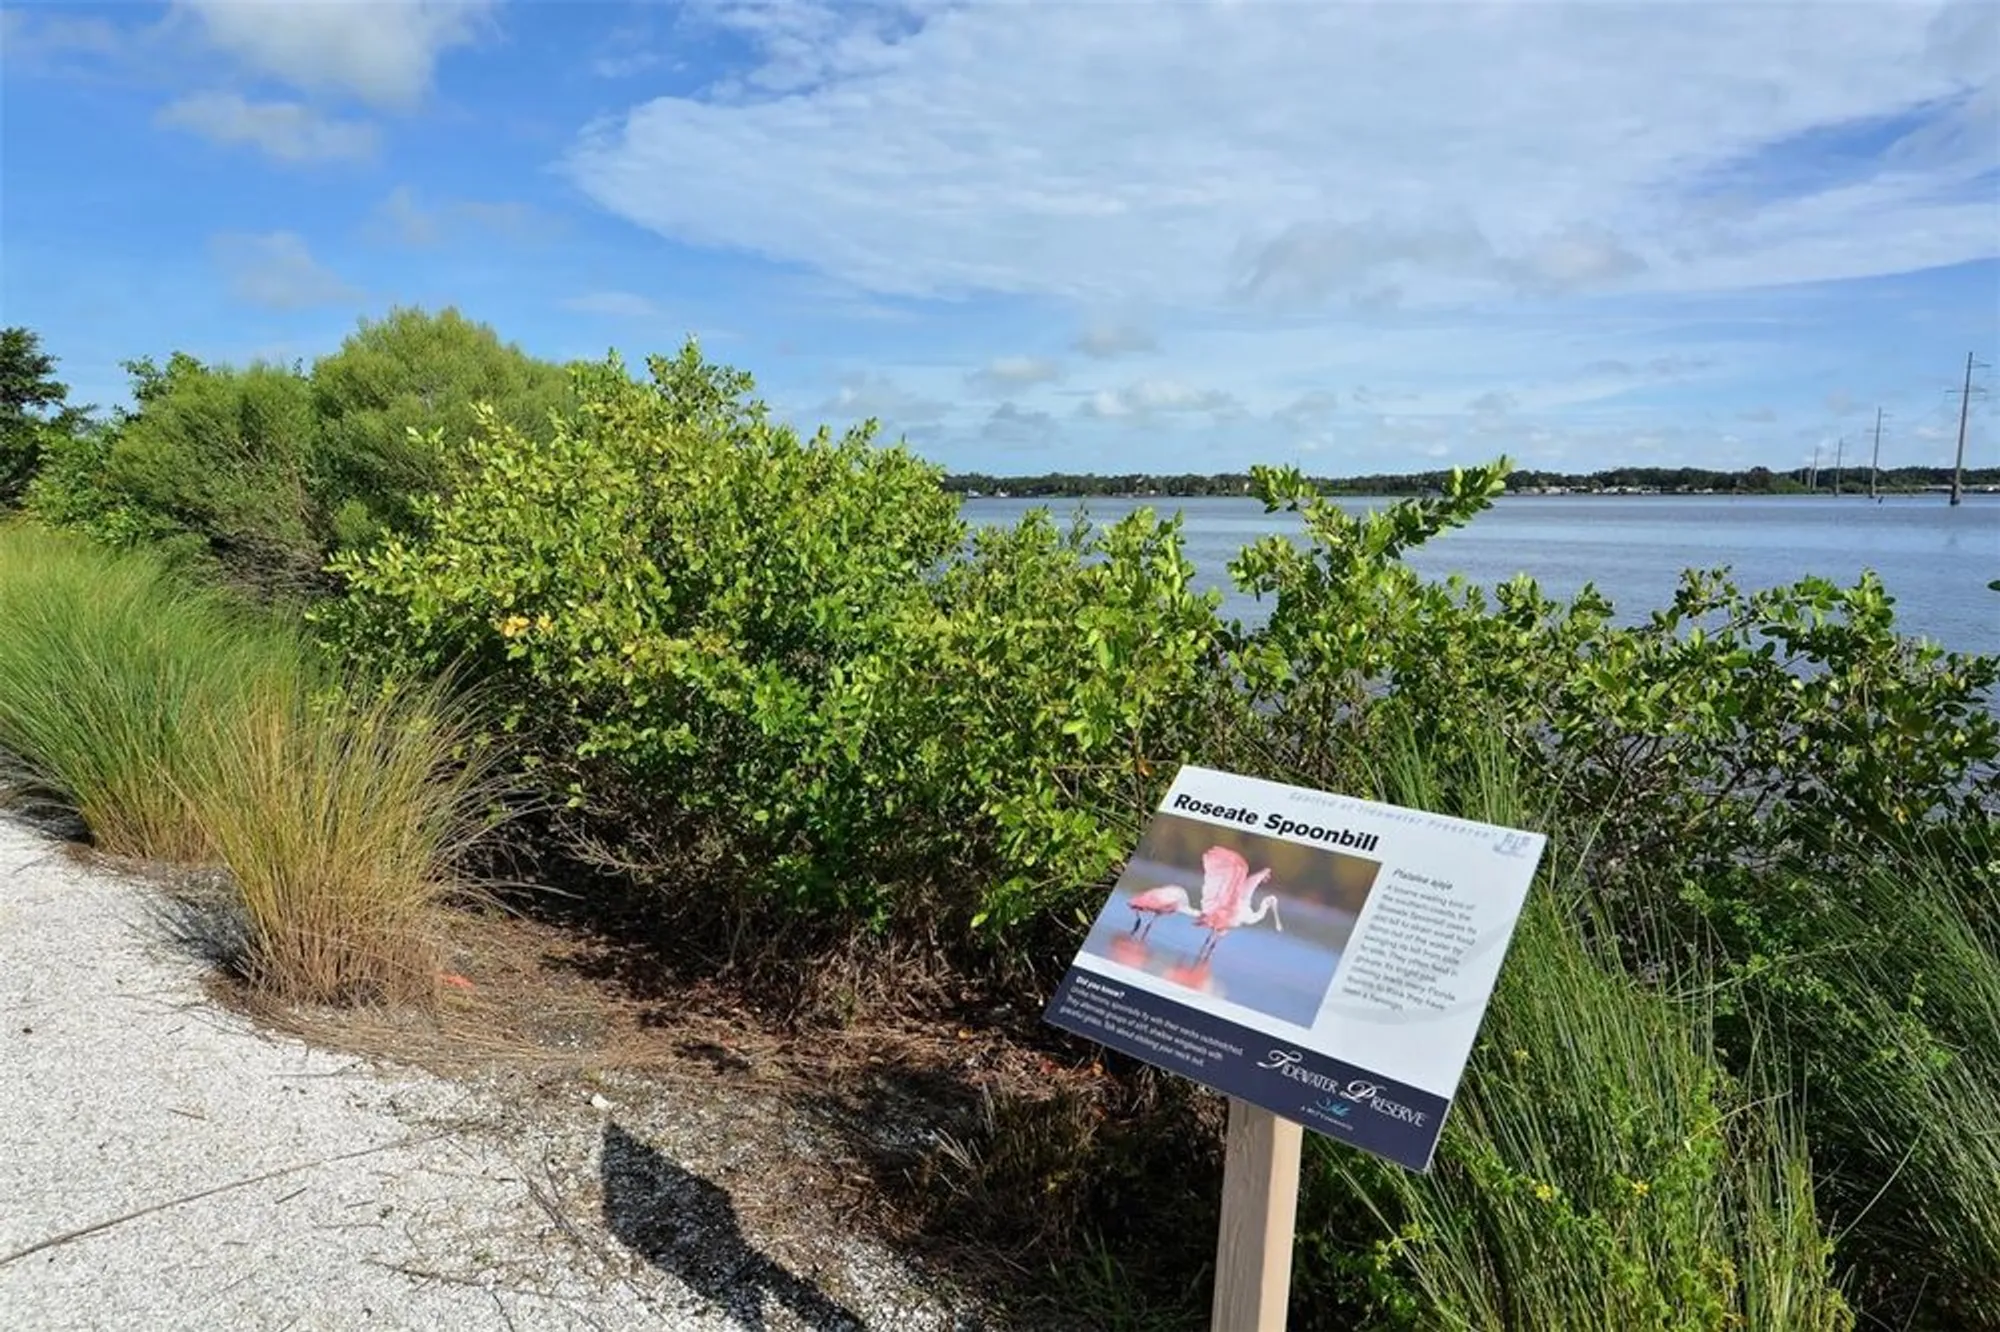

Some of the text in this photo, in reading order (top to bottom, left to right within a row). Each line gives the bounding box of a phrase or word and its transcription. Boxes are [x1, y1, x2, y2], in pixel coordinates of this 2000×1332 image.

[1174, 793, 1379, 852] Roseate Spoonbill
[1256, 1050, 1339, 1095] TIDEWATER
[1339, 1080, 1427, 1126] PRESERVE
